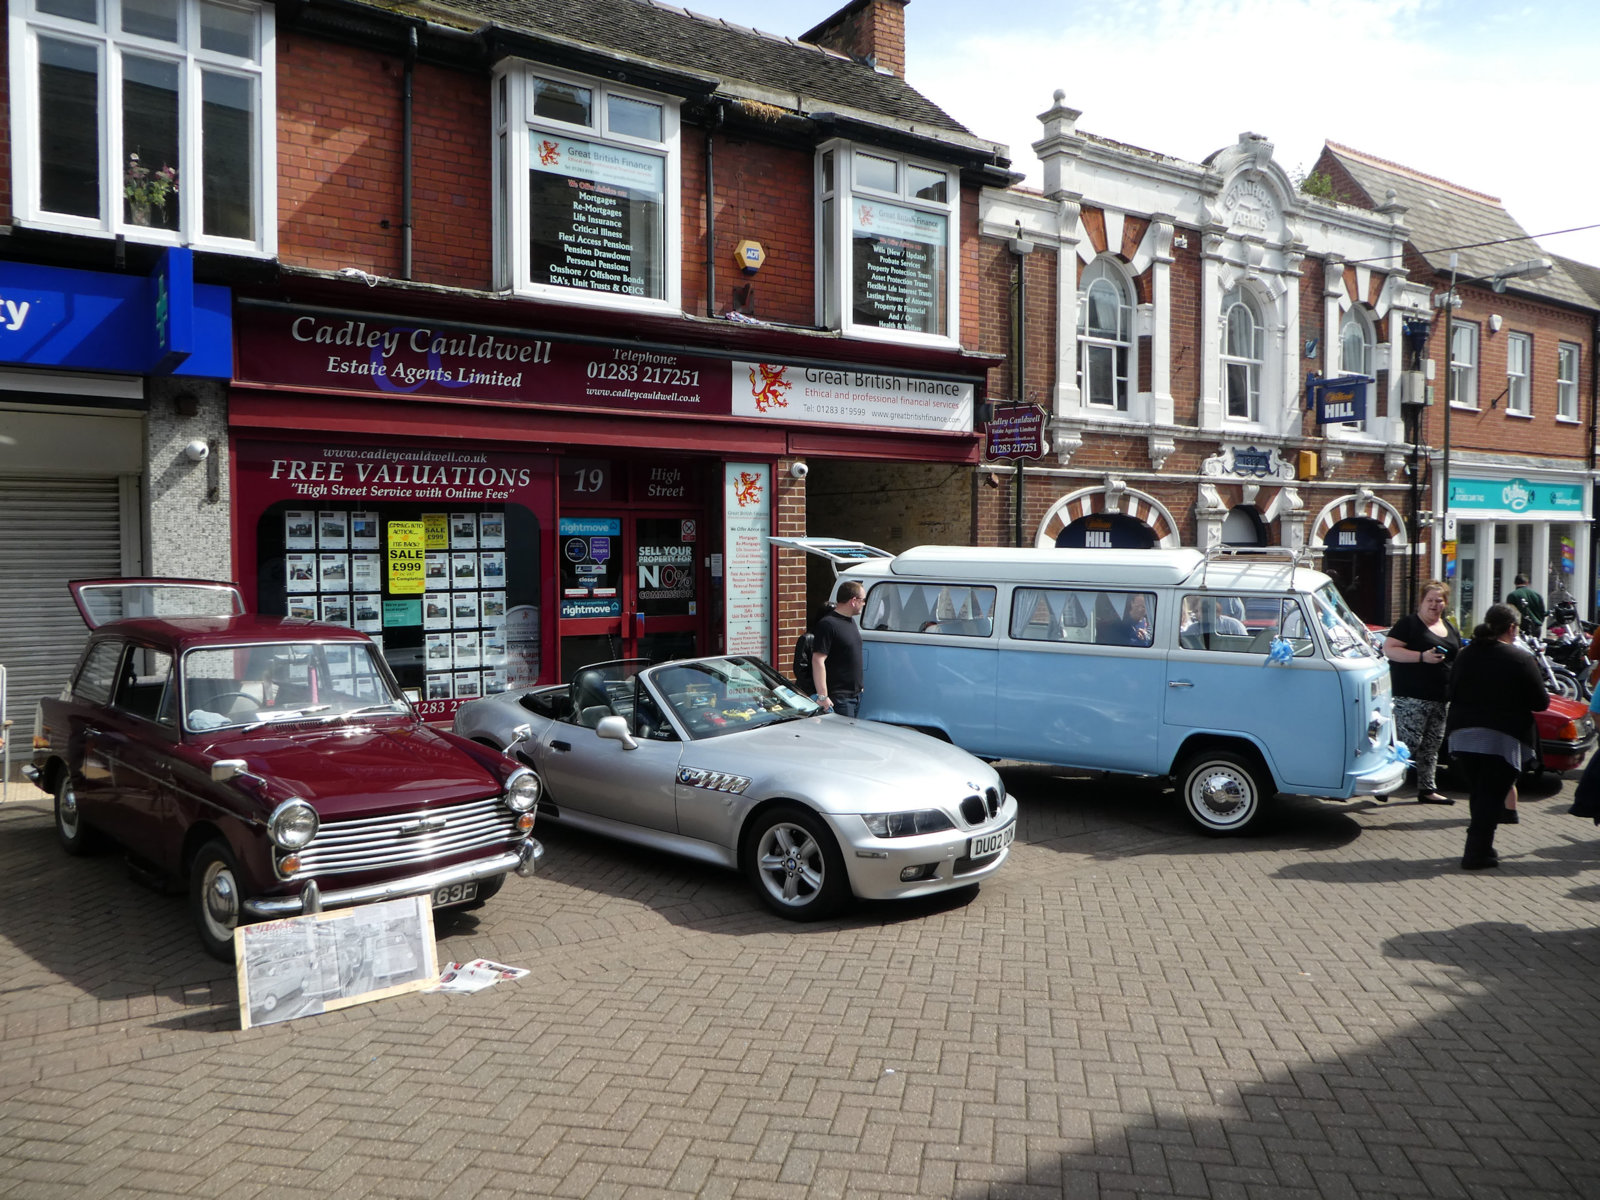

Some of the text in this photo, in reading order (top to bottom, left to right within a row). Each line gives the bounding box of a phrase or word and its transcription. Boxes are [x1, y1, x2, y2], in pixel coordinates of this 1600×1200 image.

[568, 147, 591, 159] Great
[594, 152, 619, 164] British
[622, 157, 653, 171] Finance
[579, 191, 616, 206] Mortgages
[573, 201, 622, 217] Re-Mortgages
[573, 212, 622, 227] Life Insurance
[1232, 209, 1268, 232] ARMS
[573, 223, 622, 238] Critical Illness
[559, 232, 633, 251] Flexi Access Pensions
[564, 244, 631, 261] Pension Drawdown
[566, 255, 629, 272] Personal Pensions
[867, 263, 889, 274] Property
[890, 267, 916, 277] Protection
[880, 256, 920, 269] Probate Services
[549, 264, 581, 276] Onshore
[590, 270, 621, 282] Offshore
[622, 274, 644, 285] Bonds
[887, 275, 912, 286] Protection
[572, 278, 588, 288] Unit
[590, 280, 610, 291] Trusts
[613, 283, 619, 292] &
[622, 285, 644, 295] OEICS
[866, 291, 885, 301] Lasting
[874, 301, 896, 312] Property
[888, 312, 900, 321] And
[291, 316, 552, 364] Cadley Cauldwell
[612, 348, 677, 366] Telephone:
[327, 355, 523, 388] Estate Agents Limited
[587, 361, 700, 387] 01283 217251
[805, 367, 960, 397] Great British Finance
[586, 388, 700, 403] www.cadleycauldwell.co.uk
[805, 387, 960, 410] Ethical and professional financial services
[816, 404, 838, 414] 01283
[1324, 402, 1355, 419] HILL
[323, 448, 488, 463] www.cadleycauldwell.co.uk
[990, 443, 1037, 454] 01283 217251
[269, 459, 530, 487] FREE VALUATIONS
[573, 468, 604, 493] 19
[650, 467, 681, 485] High
[331, 484, 368, 496] Street
[370, 485, 412, 497] Service
[415, 487, 442, 498] with
[445, 487, 483, 499] Online
[647, 484, 685, 497] Street
[560, 522, 609, 534] rightmove
[1085, 531, 1113, 548] HILL
[1338, 531, 1357, 546] HILL
[390, 549, 423, 559] SALE
[638, 546, 692, 556] SELL YOUR
[638, 555, 692, 563] PROPERTY FOR
[392, 563, 422, 572] £999
[639, 590, 694, 600] COMMISSION
[562, 605, 611, 617] rightmove
[975, 833, 1002, 856] DU02
